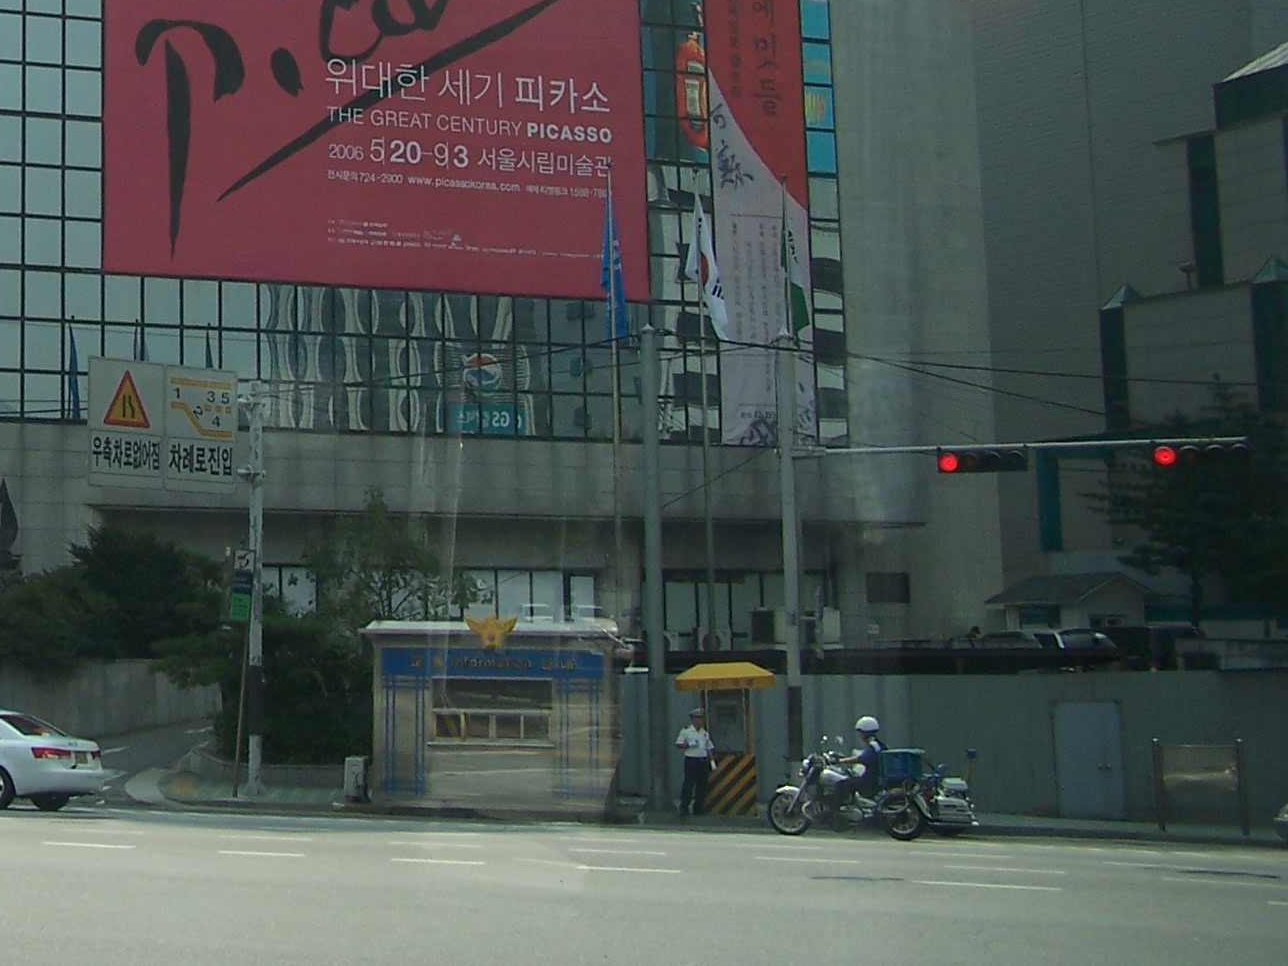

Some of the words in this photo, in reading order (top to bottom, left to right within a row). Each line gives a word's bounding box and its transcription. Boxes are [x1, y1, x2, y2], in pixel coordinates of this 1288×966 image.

[325, 58, 430, 101] 위대한
[438, 69, 504, 108] 세기
[515, 75, 611, 115] 피카소
[326, 105, 364, 126] THE
[370, 109, 432, 130] GREAT
[436, 114, 523, 137] CENTURY
[526, 121, 612, 144] PICASSO
[328, 143, 364, 161] 2006
[478, 147, 611, 178] 서울시립미술관
[173, 387, 181, 399] 1
[207, 391, 216, 403] 3
[221, 392, 230, 404] 5
[193, 405, 204, 420] 2
[212, 415, 221, 427] 4
[169, 443, 233, 476] 차례로진입
